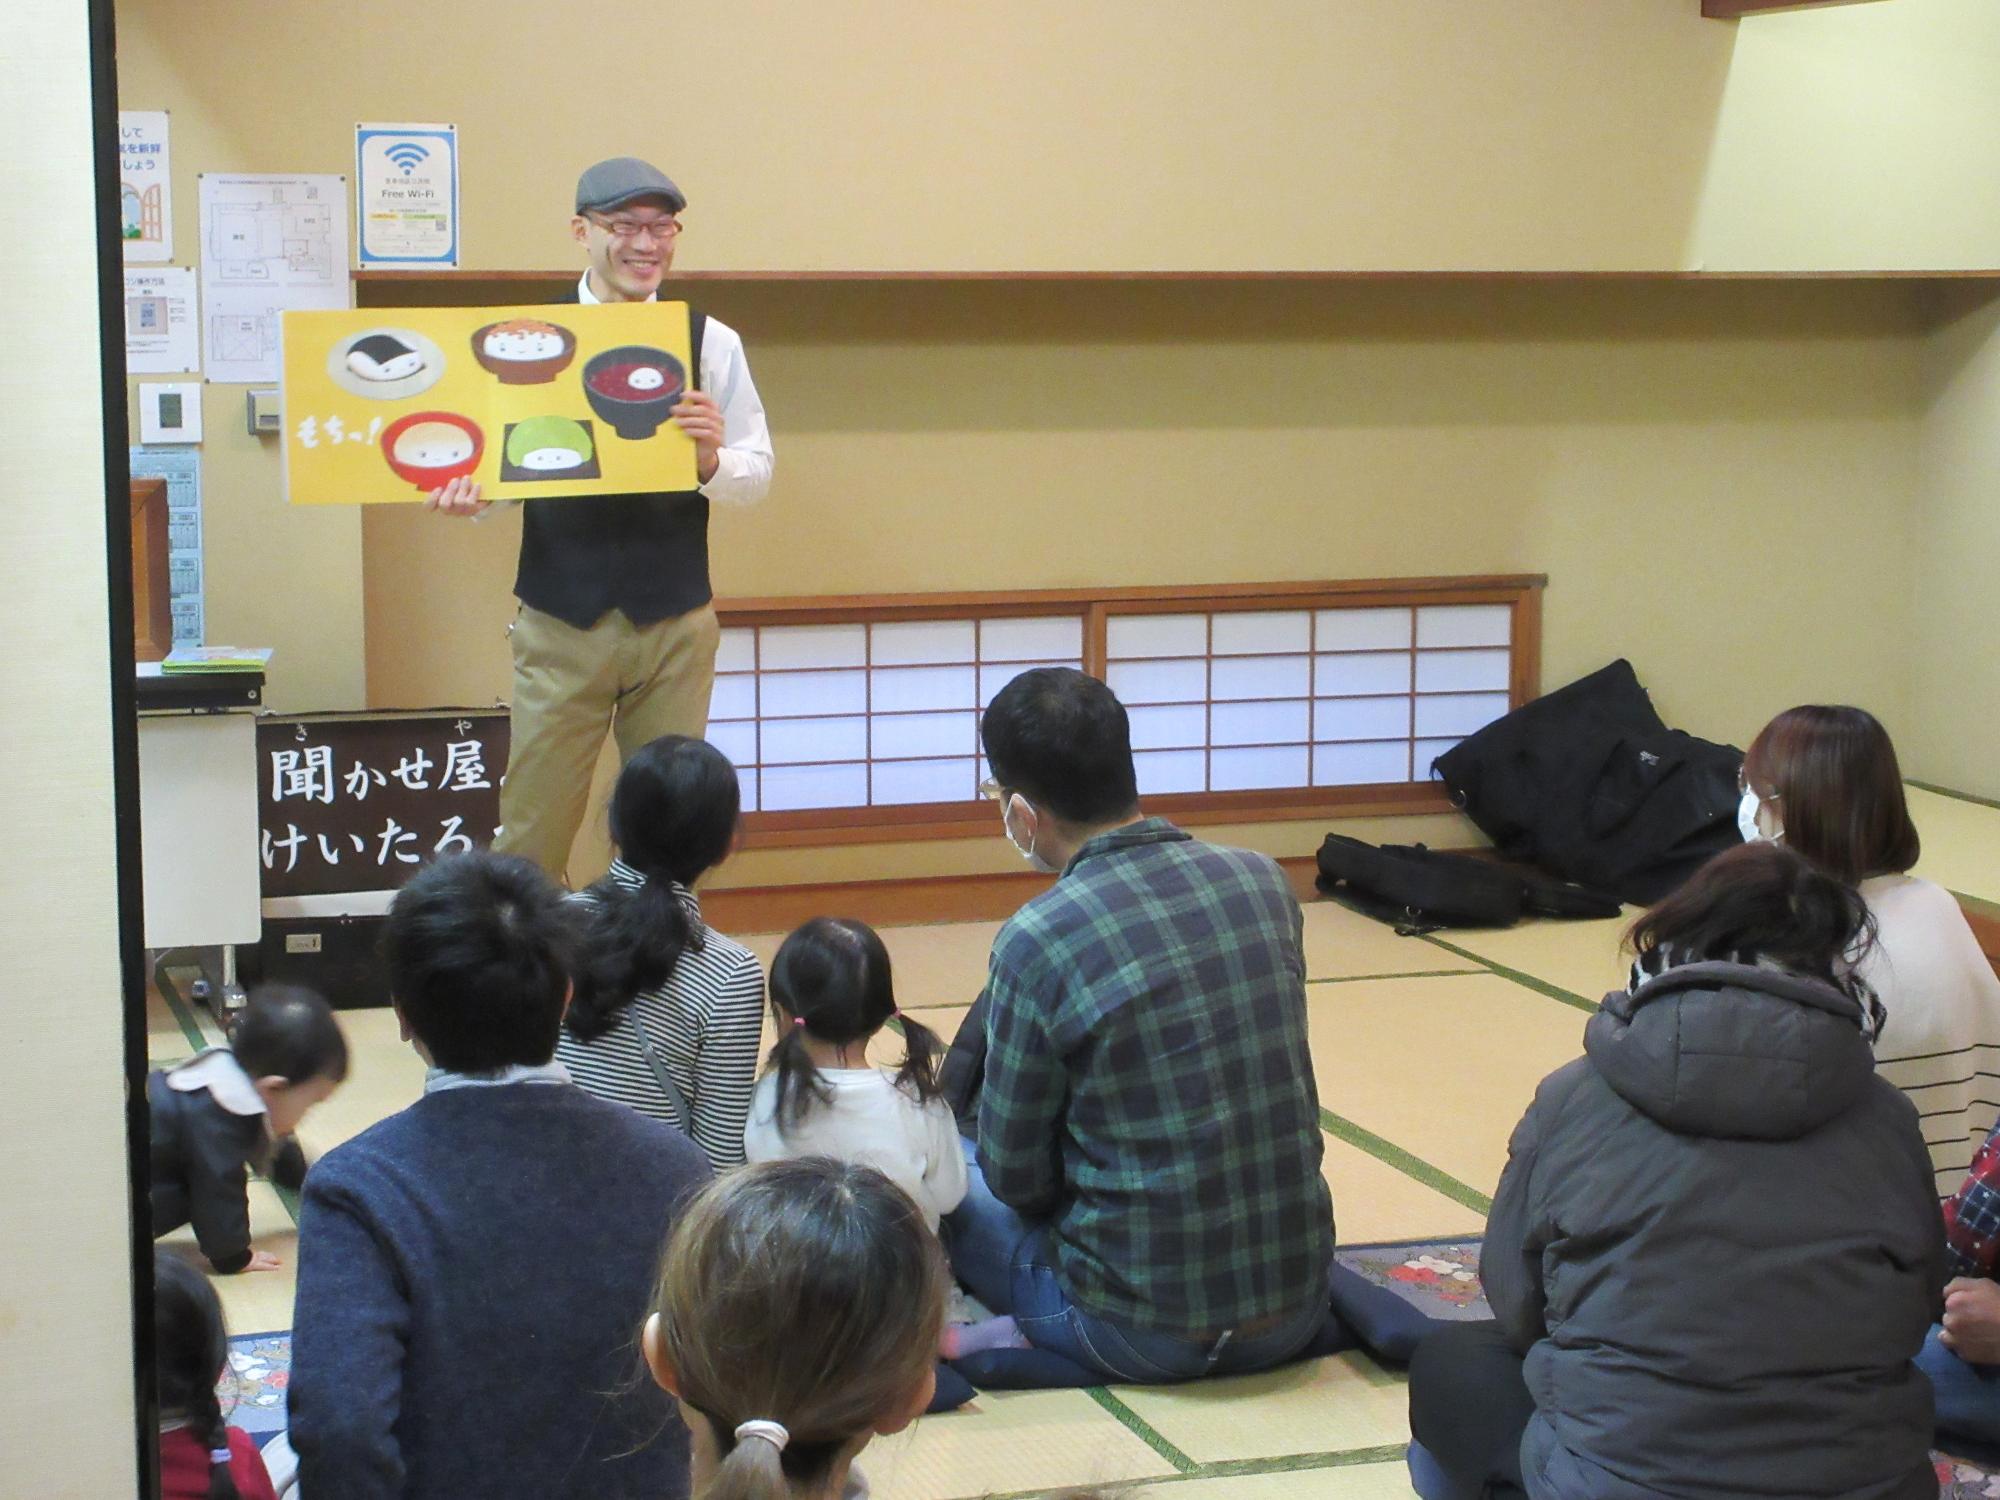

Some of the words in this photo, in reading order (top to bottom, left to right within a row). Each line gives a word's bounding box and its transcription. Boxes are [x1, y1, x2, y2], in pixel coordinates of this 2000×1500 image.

[122, 127, 144, 138] して
[123, 159, 155, 170] しょう
[381, 189, 404, 198] Free
[408, 189, 434, 198] Wi-Fi
[295, 724, 308, 742] き
[455, 719, 472, 736] や
[262, 815, 504, 873] けいたろ
